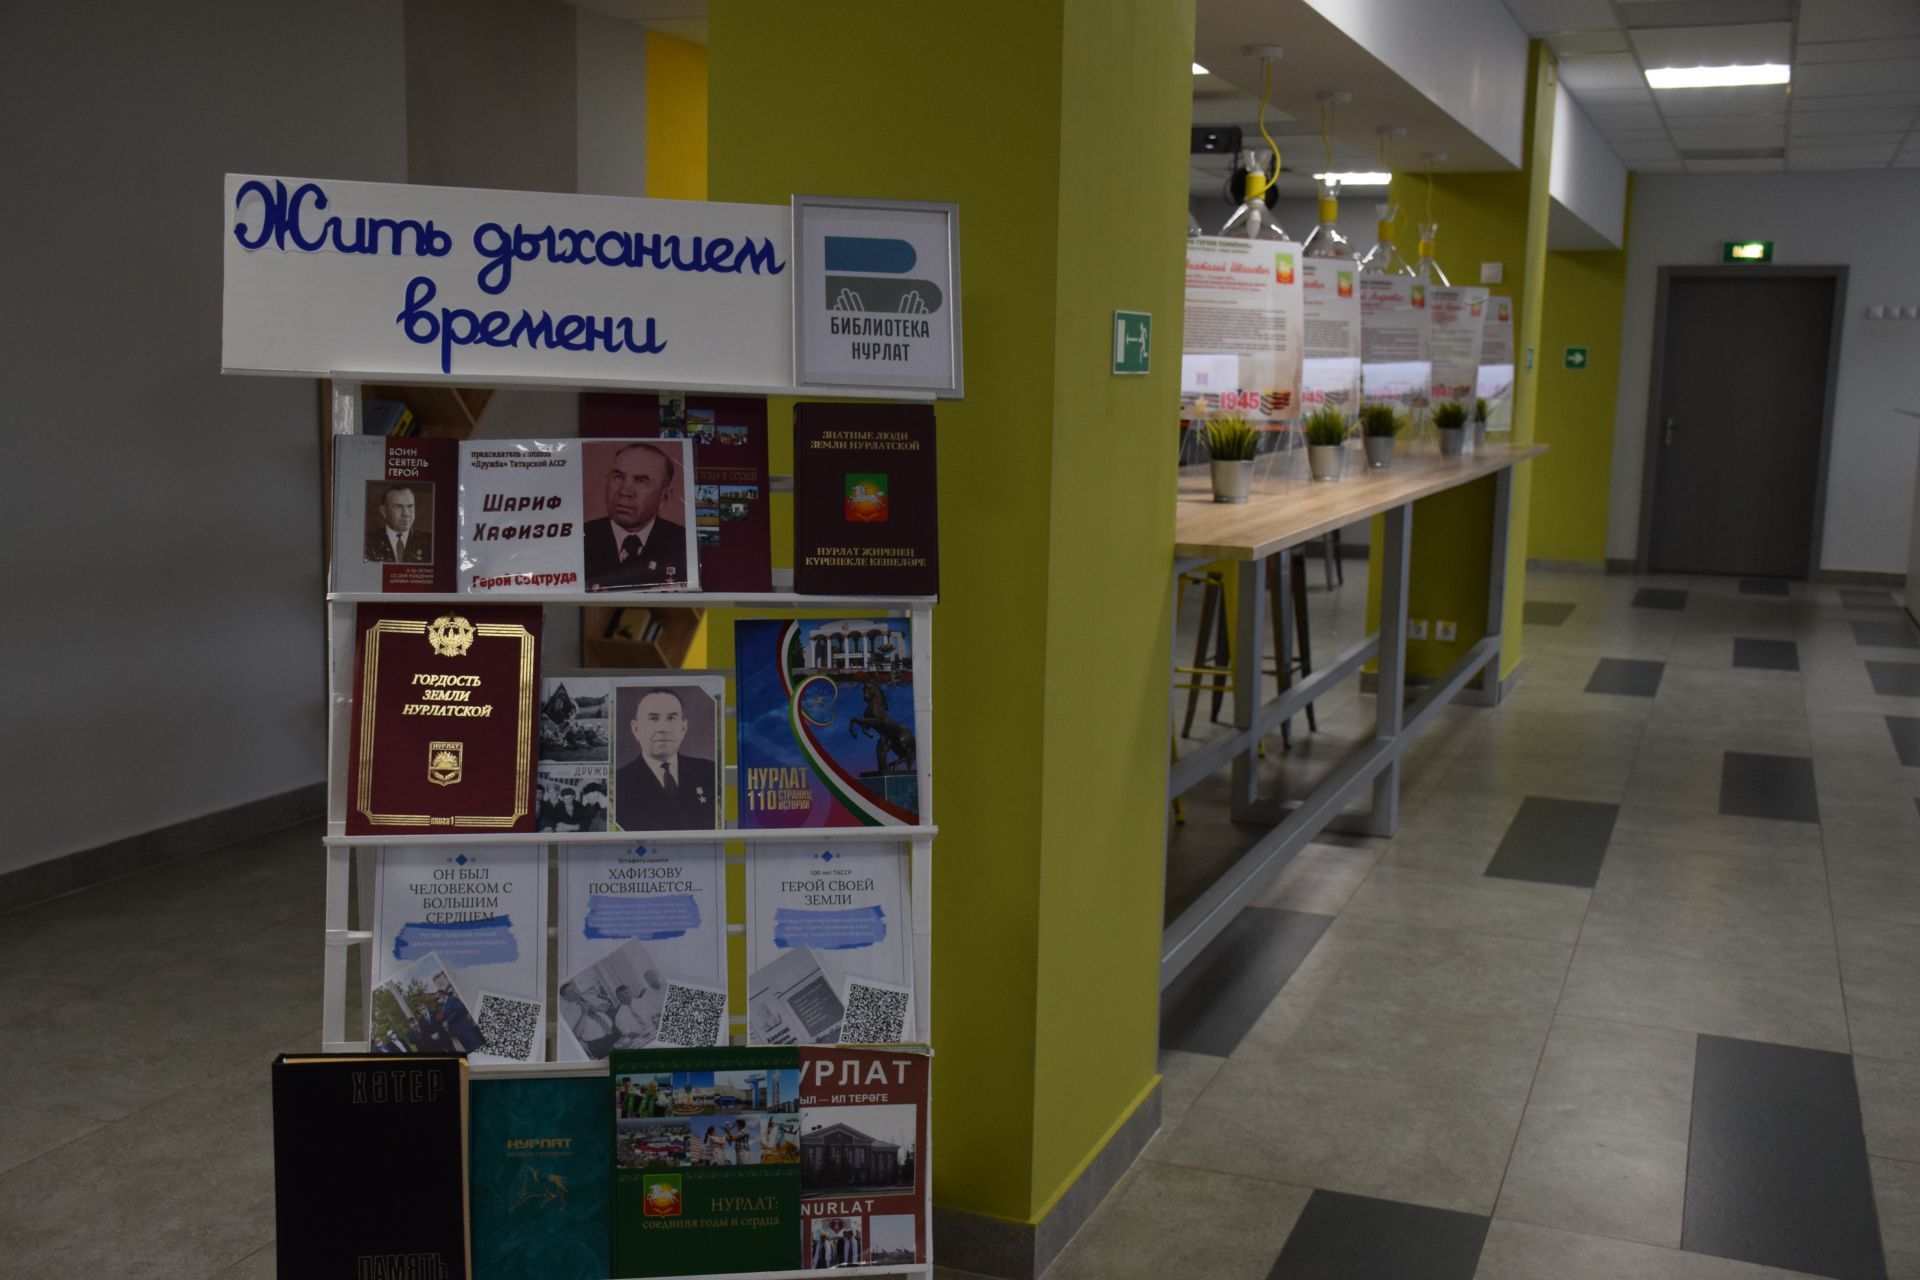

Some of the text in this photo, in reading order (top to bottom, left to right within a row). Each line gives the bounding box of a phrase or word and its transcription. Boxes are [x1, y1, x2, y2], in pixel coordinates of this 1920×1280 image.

[234, 180, 787, 295] Жить дыханием
[396, 276, 668, 374] времени
[831, 317, 930, 338] БИБЛИОТЕКА
[852, 342, 910, 361] НУРЛАТ
[1220, 392, 1259, 410] 1945
[822, 430, 909, 441] ЗНАТНЫЕ ЛЮДИ
[389, 447, 418, 457] ВОИН
[810, 440, 920, 451] ЗЕМЛИ НУРЛАТСКОЙ
[471, 451, 521, 459] председатель
[388, 458, 429, 468] СЕЯТЕЛЬ
[509, 459, 547, 469] Татарской
[548, 459, 567, 467] АССР
[388, 467, 419, 477] ГЕРОЙ
[816, 547, 860, 556] НУРЛАТ
[870, 557, 927, 568] КЕШЕЛӘРЕ
[472, 571, 578, 590] Герой Соцтруда
[411, 673, 482, 687] ГОРДОСТЬ
[422, 690, 471, 702] ЗЕМЛИ
[402, 703, 494, 718] НУРЛАТСКОЙ
[747, 767, 808, 789] НУРЛАТ
[747, 790, 777, 811] 110
[433, 868, 490, 880] ОН БЫЛ
[609, 867, 683, 880] ХАФИЗОВУ
[409, 882, 513, 895] ЧЕЛОВЕКОМ С
[781, 878, 875, 892] ГЕРОЙ СВОЕЙ
[423, 897, 499, 909] БОЛЬШИМ
[804, 894, 852, 906] ЗЕМЛИ
[426, 910, 494, 923] СЕРДЦЕМ
[352, 1070, 444, 1105] ХӘТЕР
[831, 1095, 846, 1104] ИЛ
[848, 1093, 889, 1103] ТЕРӘГЕ
[506, 1137, 573, 1150] НУРЛАТ
[711, 1196, 779, 1212] НУРЛАТ:
[801, 1200, 874, 1218] NURLAT
[741, 1215, 780, 1229] сердца
